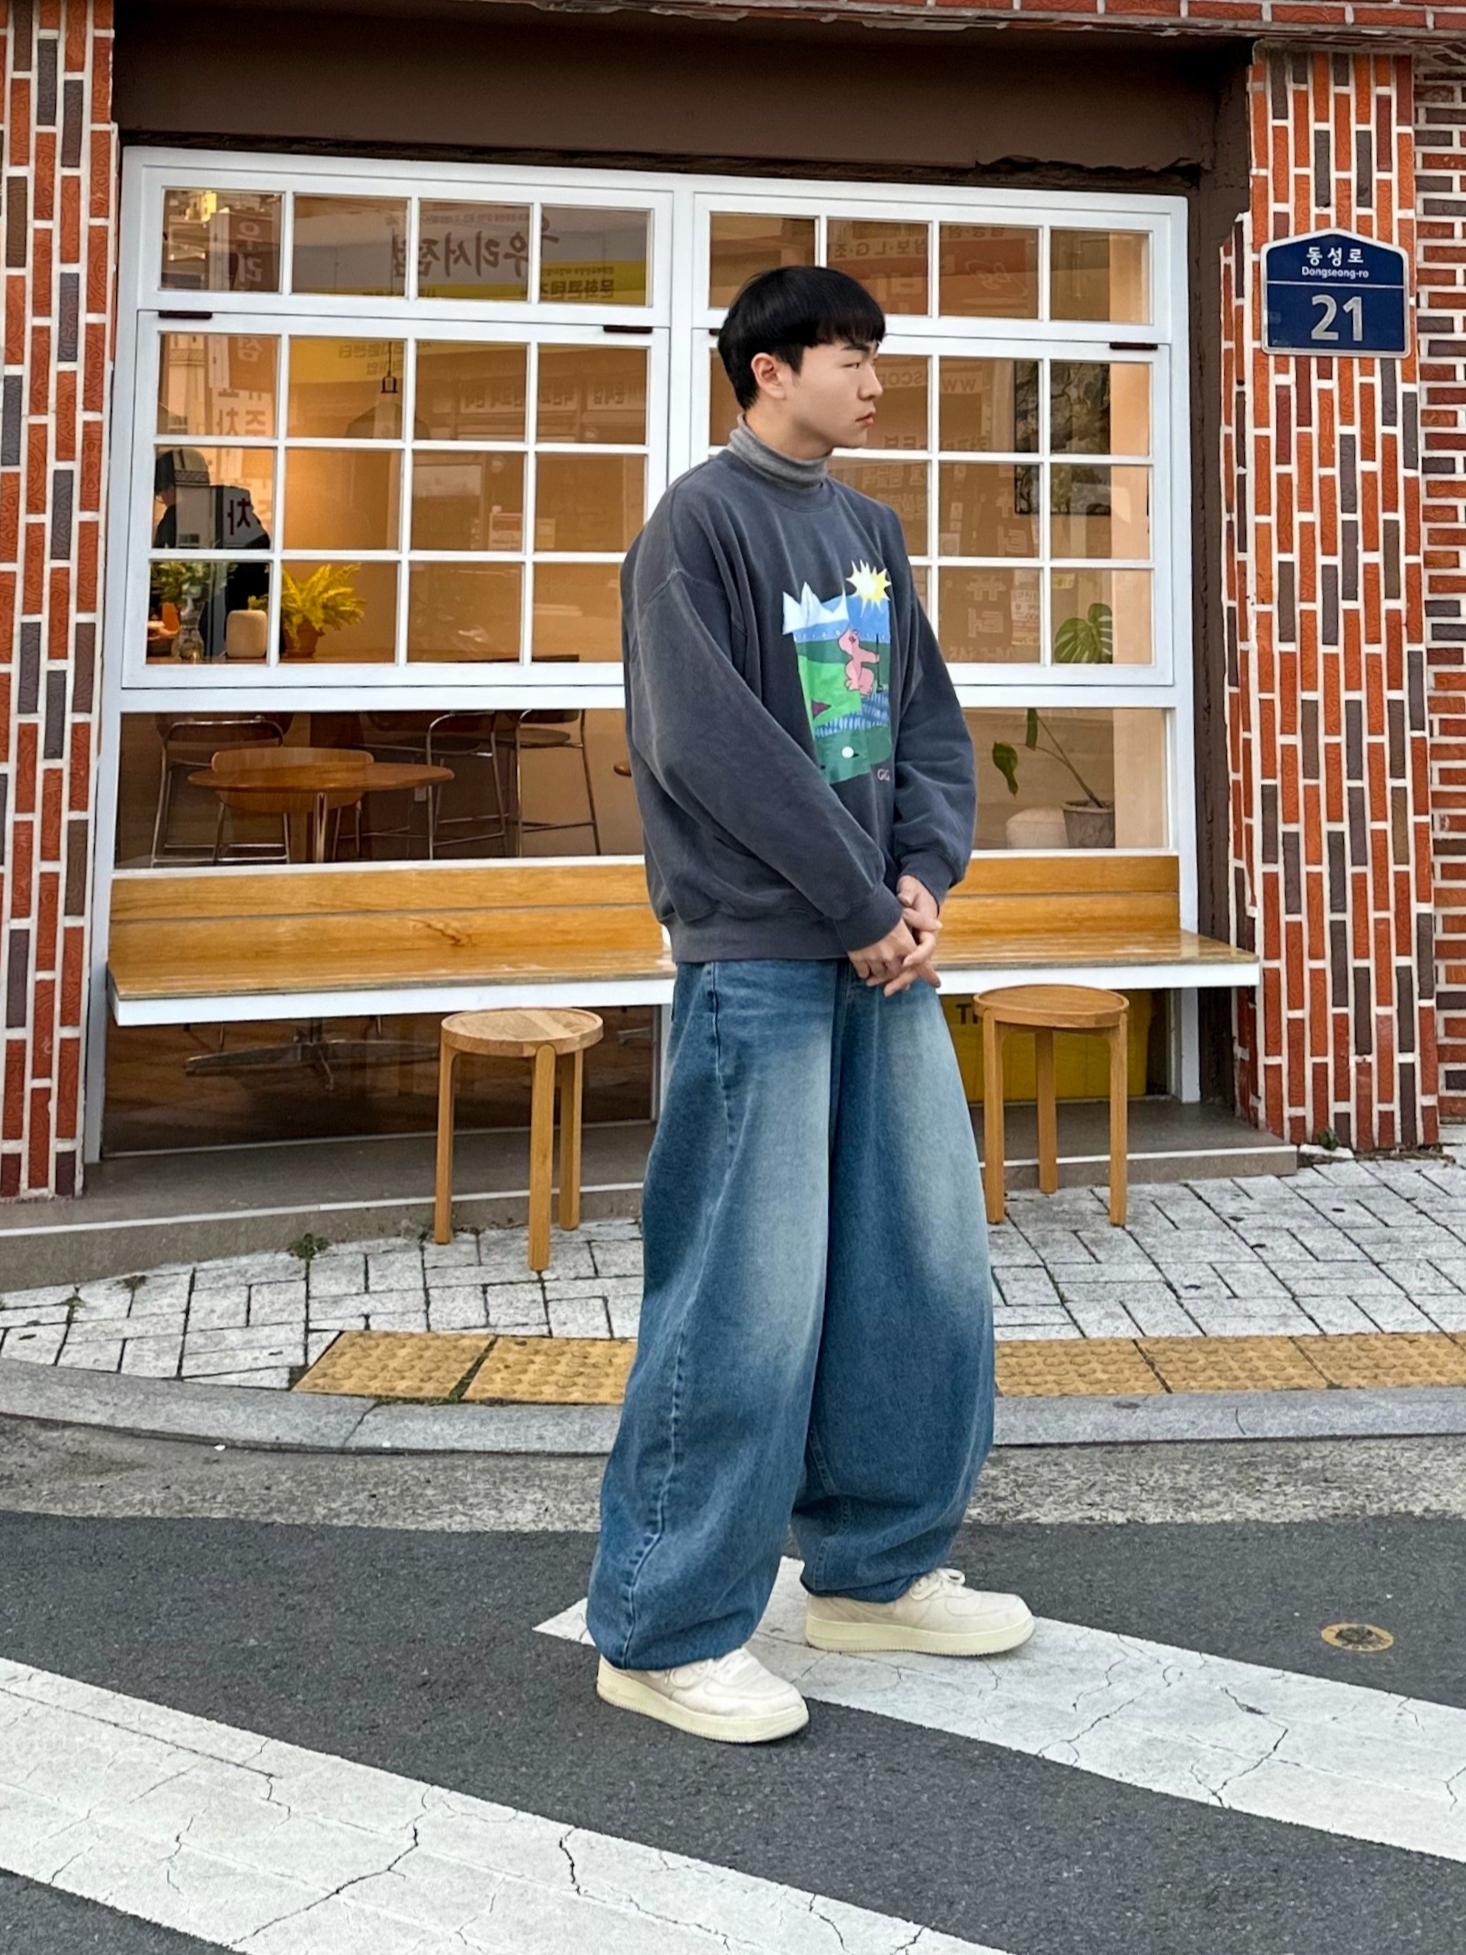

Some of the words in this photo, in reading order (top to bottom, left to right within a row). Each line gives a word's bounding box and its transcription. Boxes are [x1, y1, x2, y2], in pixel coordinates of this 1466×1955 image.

[1306, 246, 1364, 267] 동성로
[1302, 266, 1369, 279] Dongseong-ro
[1311, 294, 1363, 342] 21
